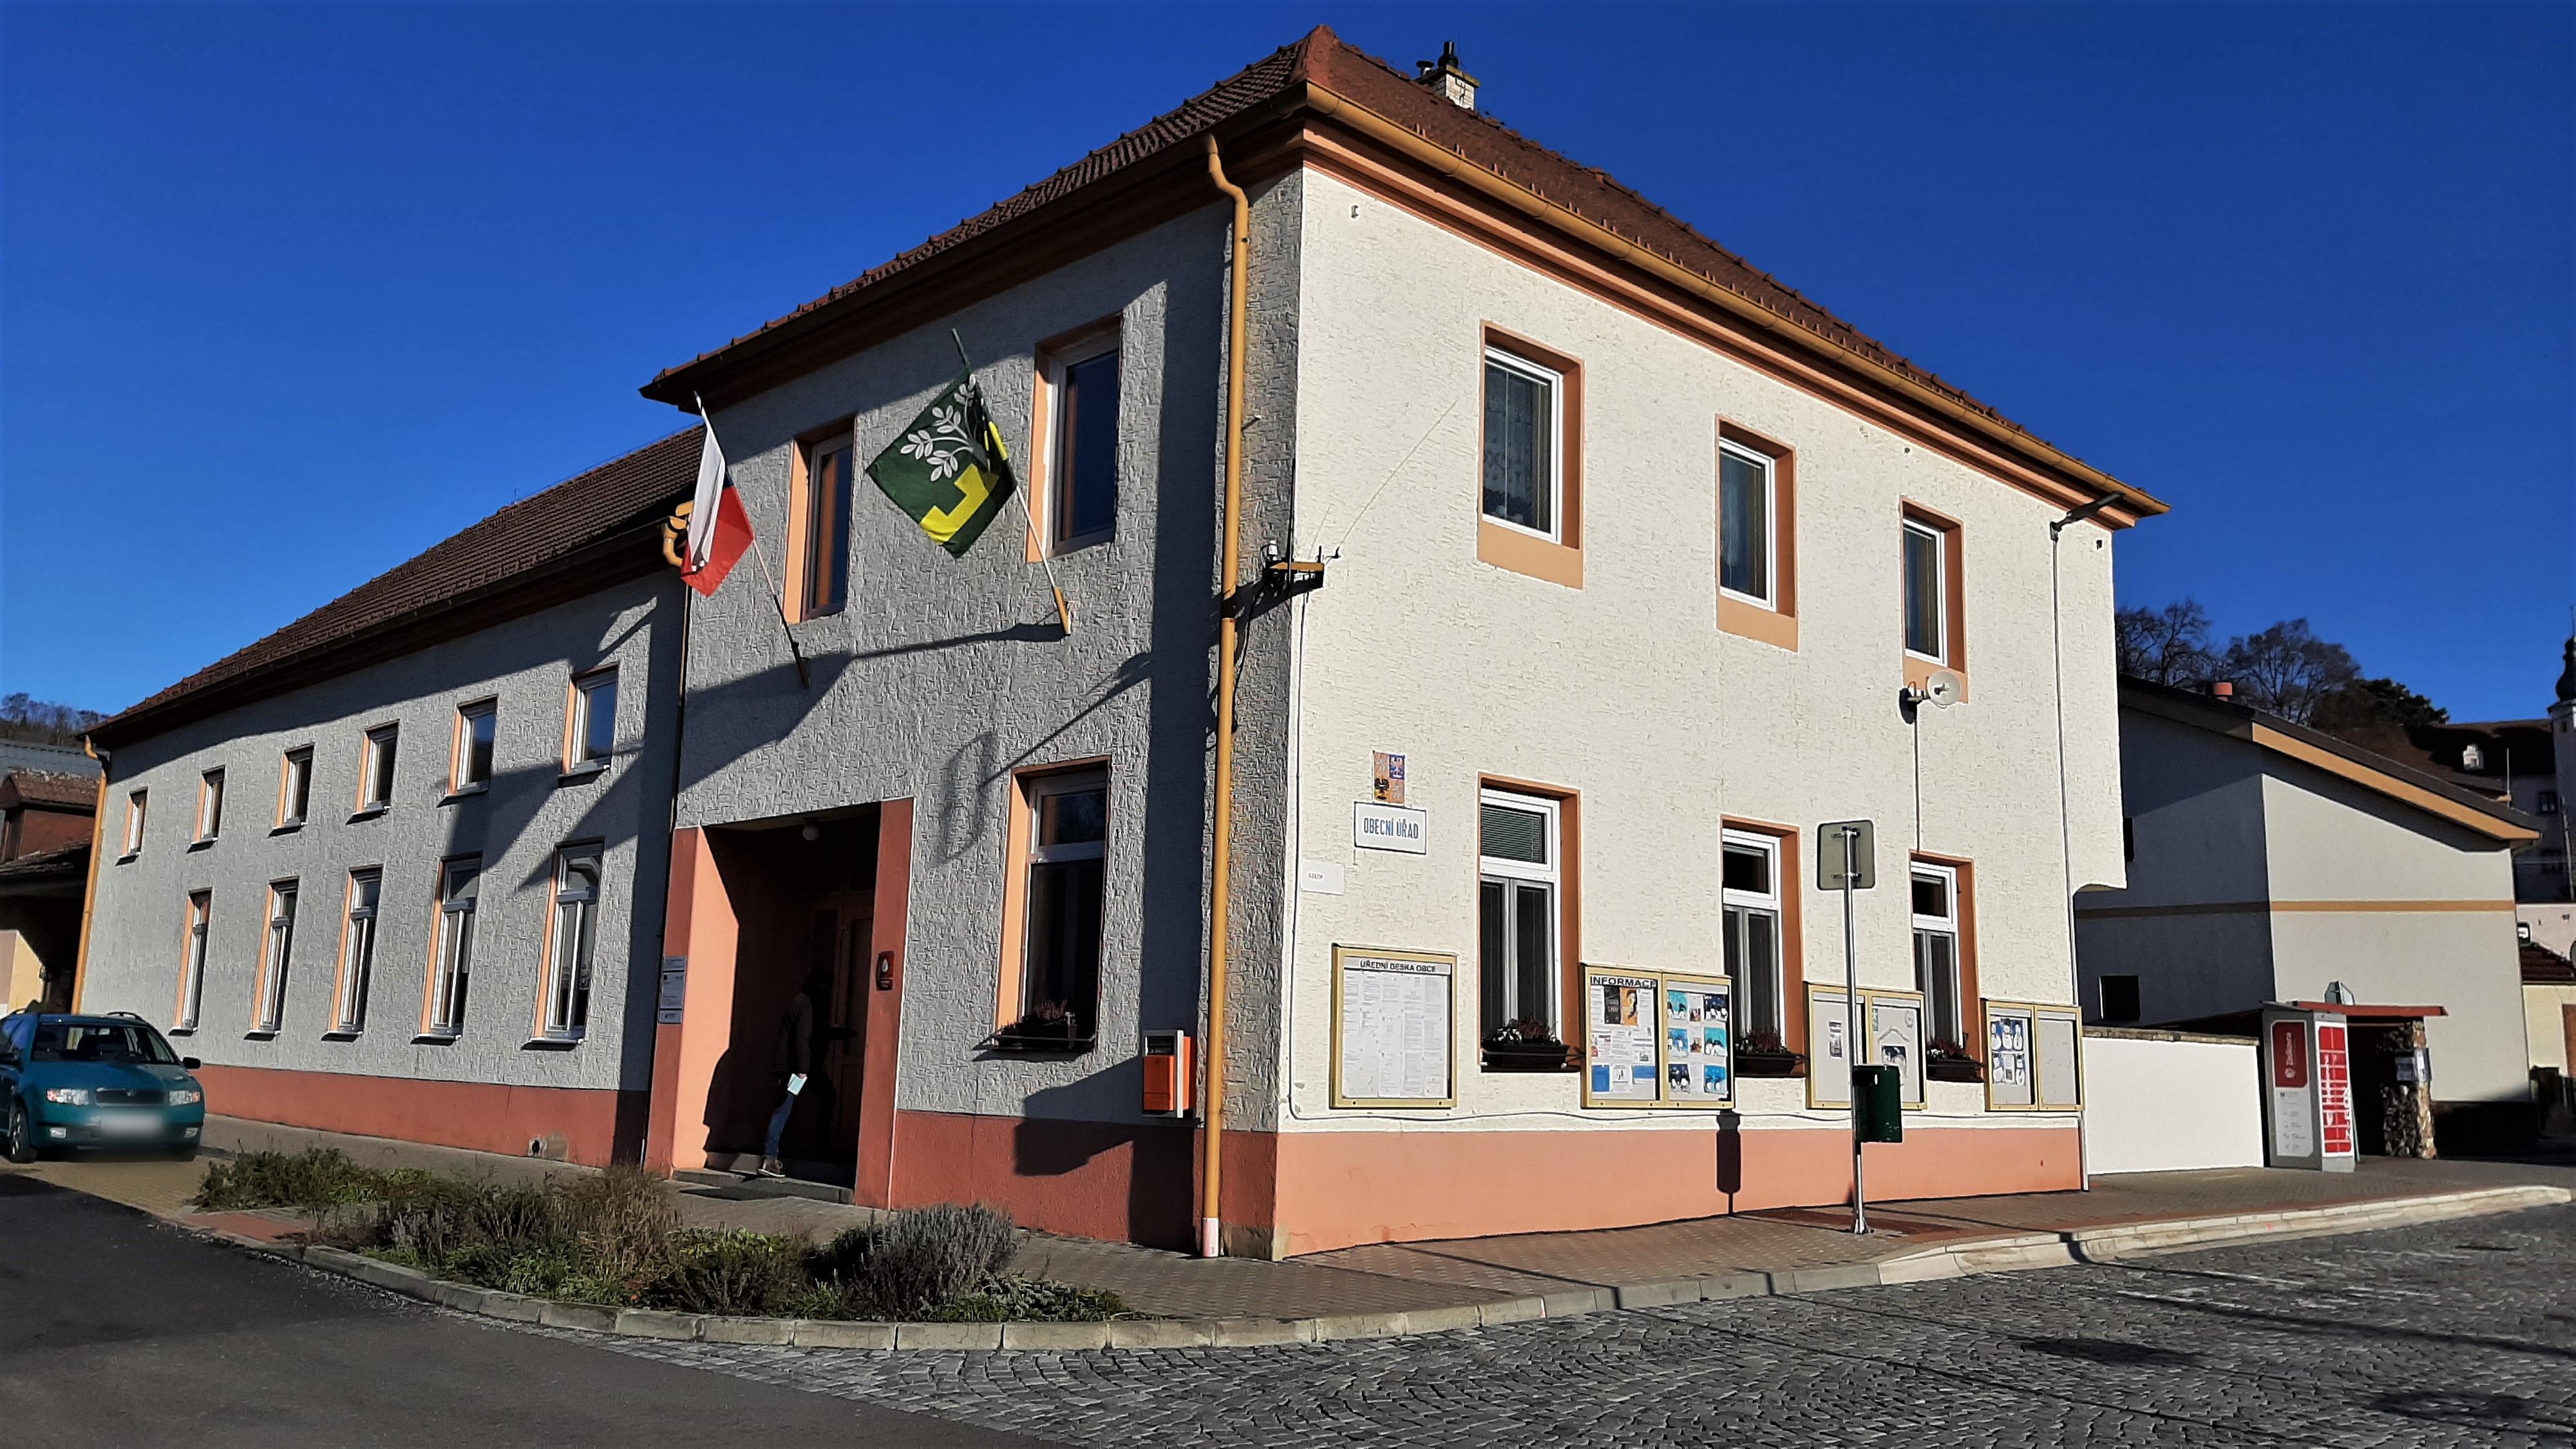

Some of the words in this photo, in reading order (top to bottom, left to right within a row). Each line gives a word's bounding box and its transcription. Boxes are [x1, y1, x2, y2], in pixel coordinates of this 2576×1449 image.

[1363, 817, 1394, 837] OBECNÍ
[1396, 818, 1419, 839] ÚŘAD
[1360, 959, 1388, 969] ÚŘEDNÍ
[1390, 962, 1415, 971] DESKA
[1590, 976, 1657, 989] INFORMACE
